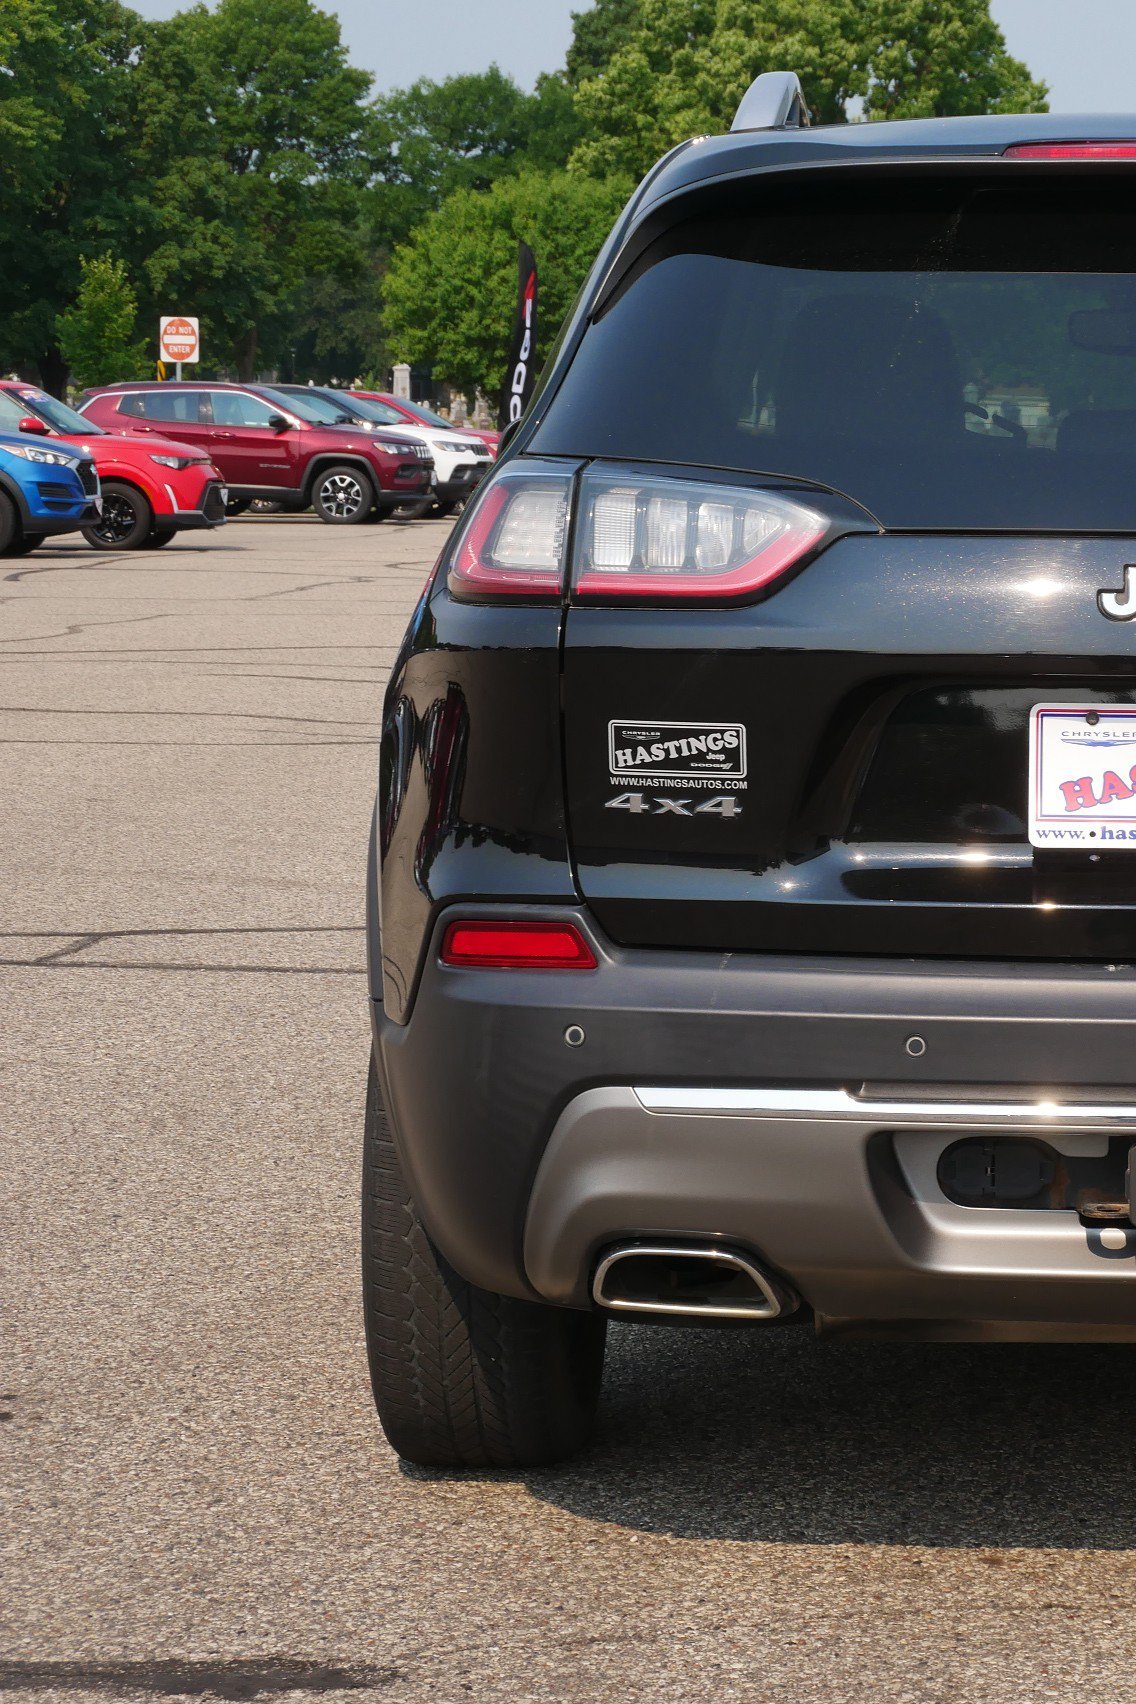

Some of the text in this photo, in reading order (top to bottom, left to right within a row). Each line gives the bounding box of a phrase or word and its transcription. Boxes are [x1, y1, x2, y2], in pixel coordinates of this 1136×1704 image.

[166, 326, 192, 334] DO NOT
[168, 345, 191, 353] ENTER
[614, 730, 739, 767] HASTINGS
[706, 752, 726, 762] Jeep
[609, 776, 748, 790] WWW.HASTINGSAUTOS.COM
